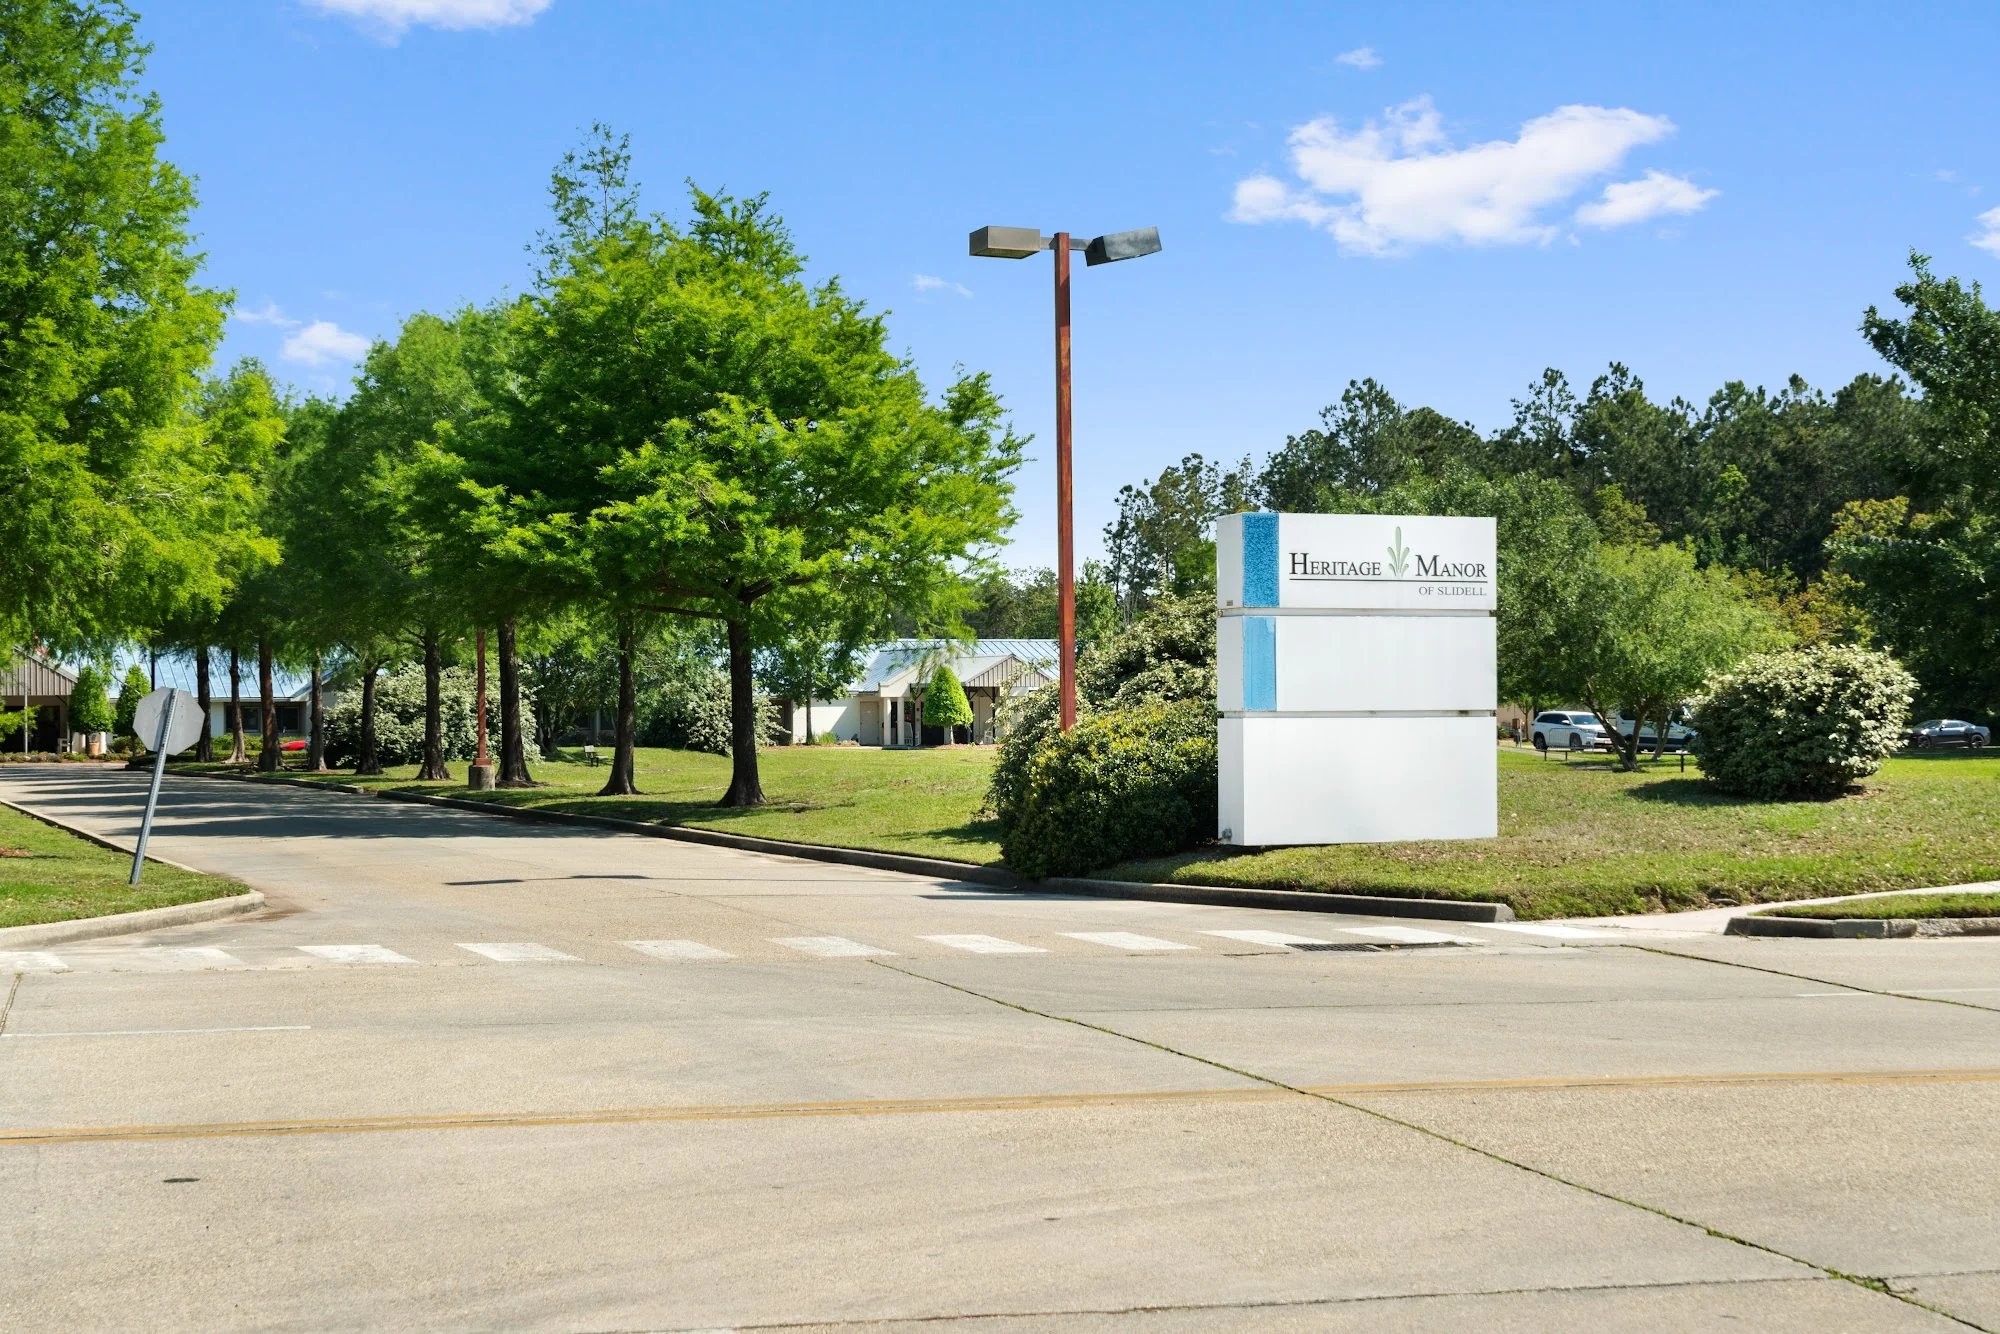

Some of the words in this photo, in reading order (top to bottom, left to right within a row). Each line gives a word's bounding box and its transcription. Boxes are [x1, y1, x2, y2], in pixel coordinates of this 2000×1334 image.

[1288, 552, 1382, 577] HERITAGE
[1414, 554, 1488, 578] MANOR
[1418, 586, 1435, 596] OF
[1437, 586, 1487, 597] SLIDELL
